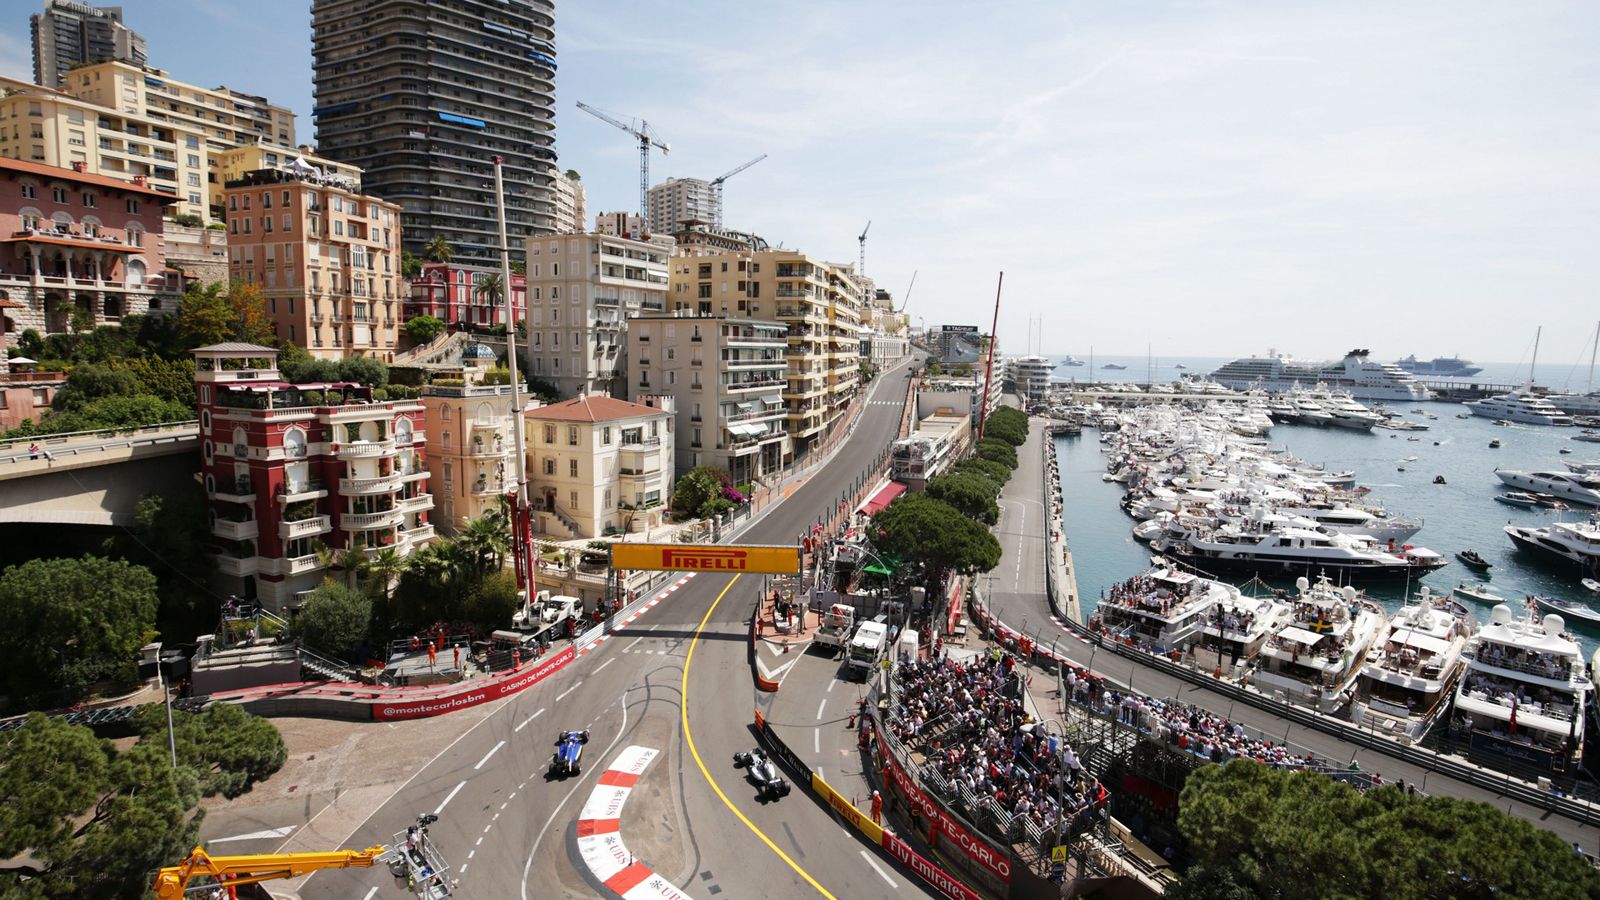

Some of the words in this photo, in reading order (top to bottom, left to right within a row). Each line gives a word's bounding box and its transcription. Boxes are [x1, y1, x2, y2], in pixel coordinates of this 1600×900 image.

[662, 549, 747, 569] PIRELLI
[500, 678, 527, 693] CASINO
[527, 673, 537, 683] DE
[536, 652, 573, 678] MONTE-CARLO
[383, 693, 486, 716] @montecarlosbm
[630, 756, 650, 773] UBS
[904, 781, 916, 801] DE
[605, 797, 622, 817] UBS
[609, 844, 629, 865] UBS
[890, 838, 909, 863] Fly
[911, 854, 966, 900] Emirates
